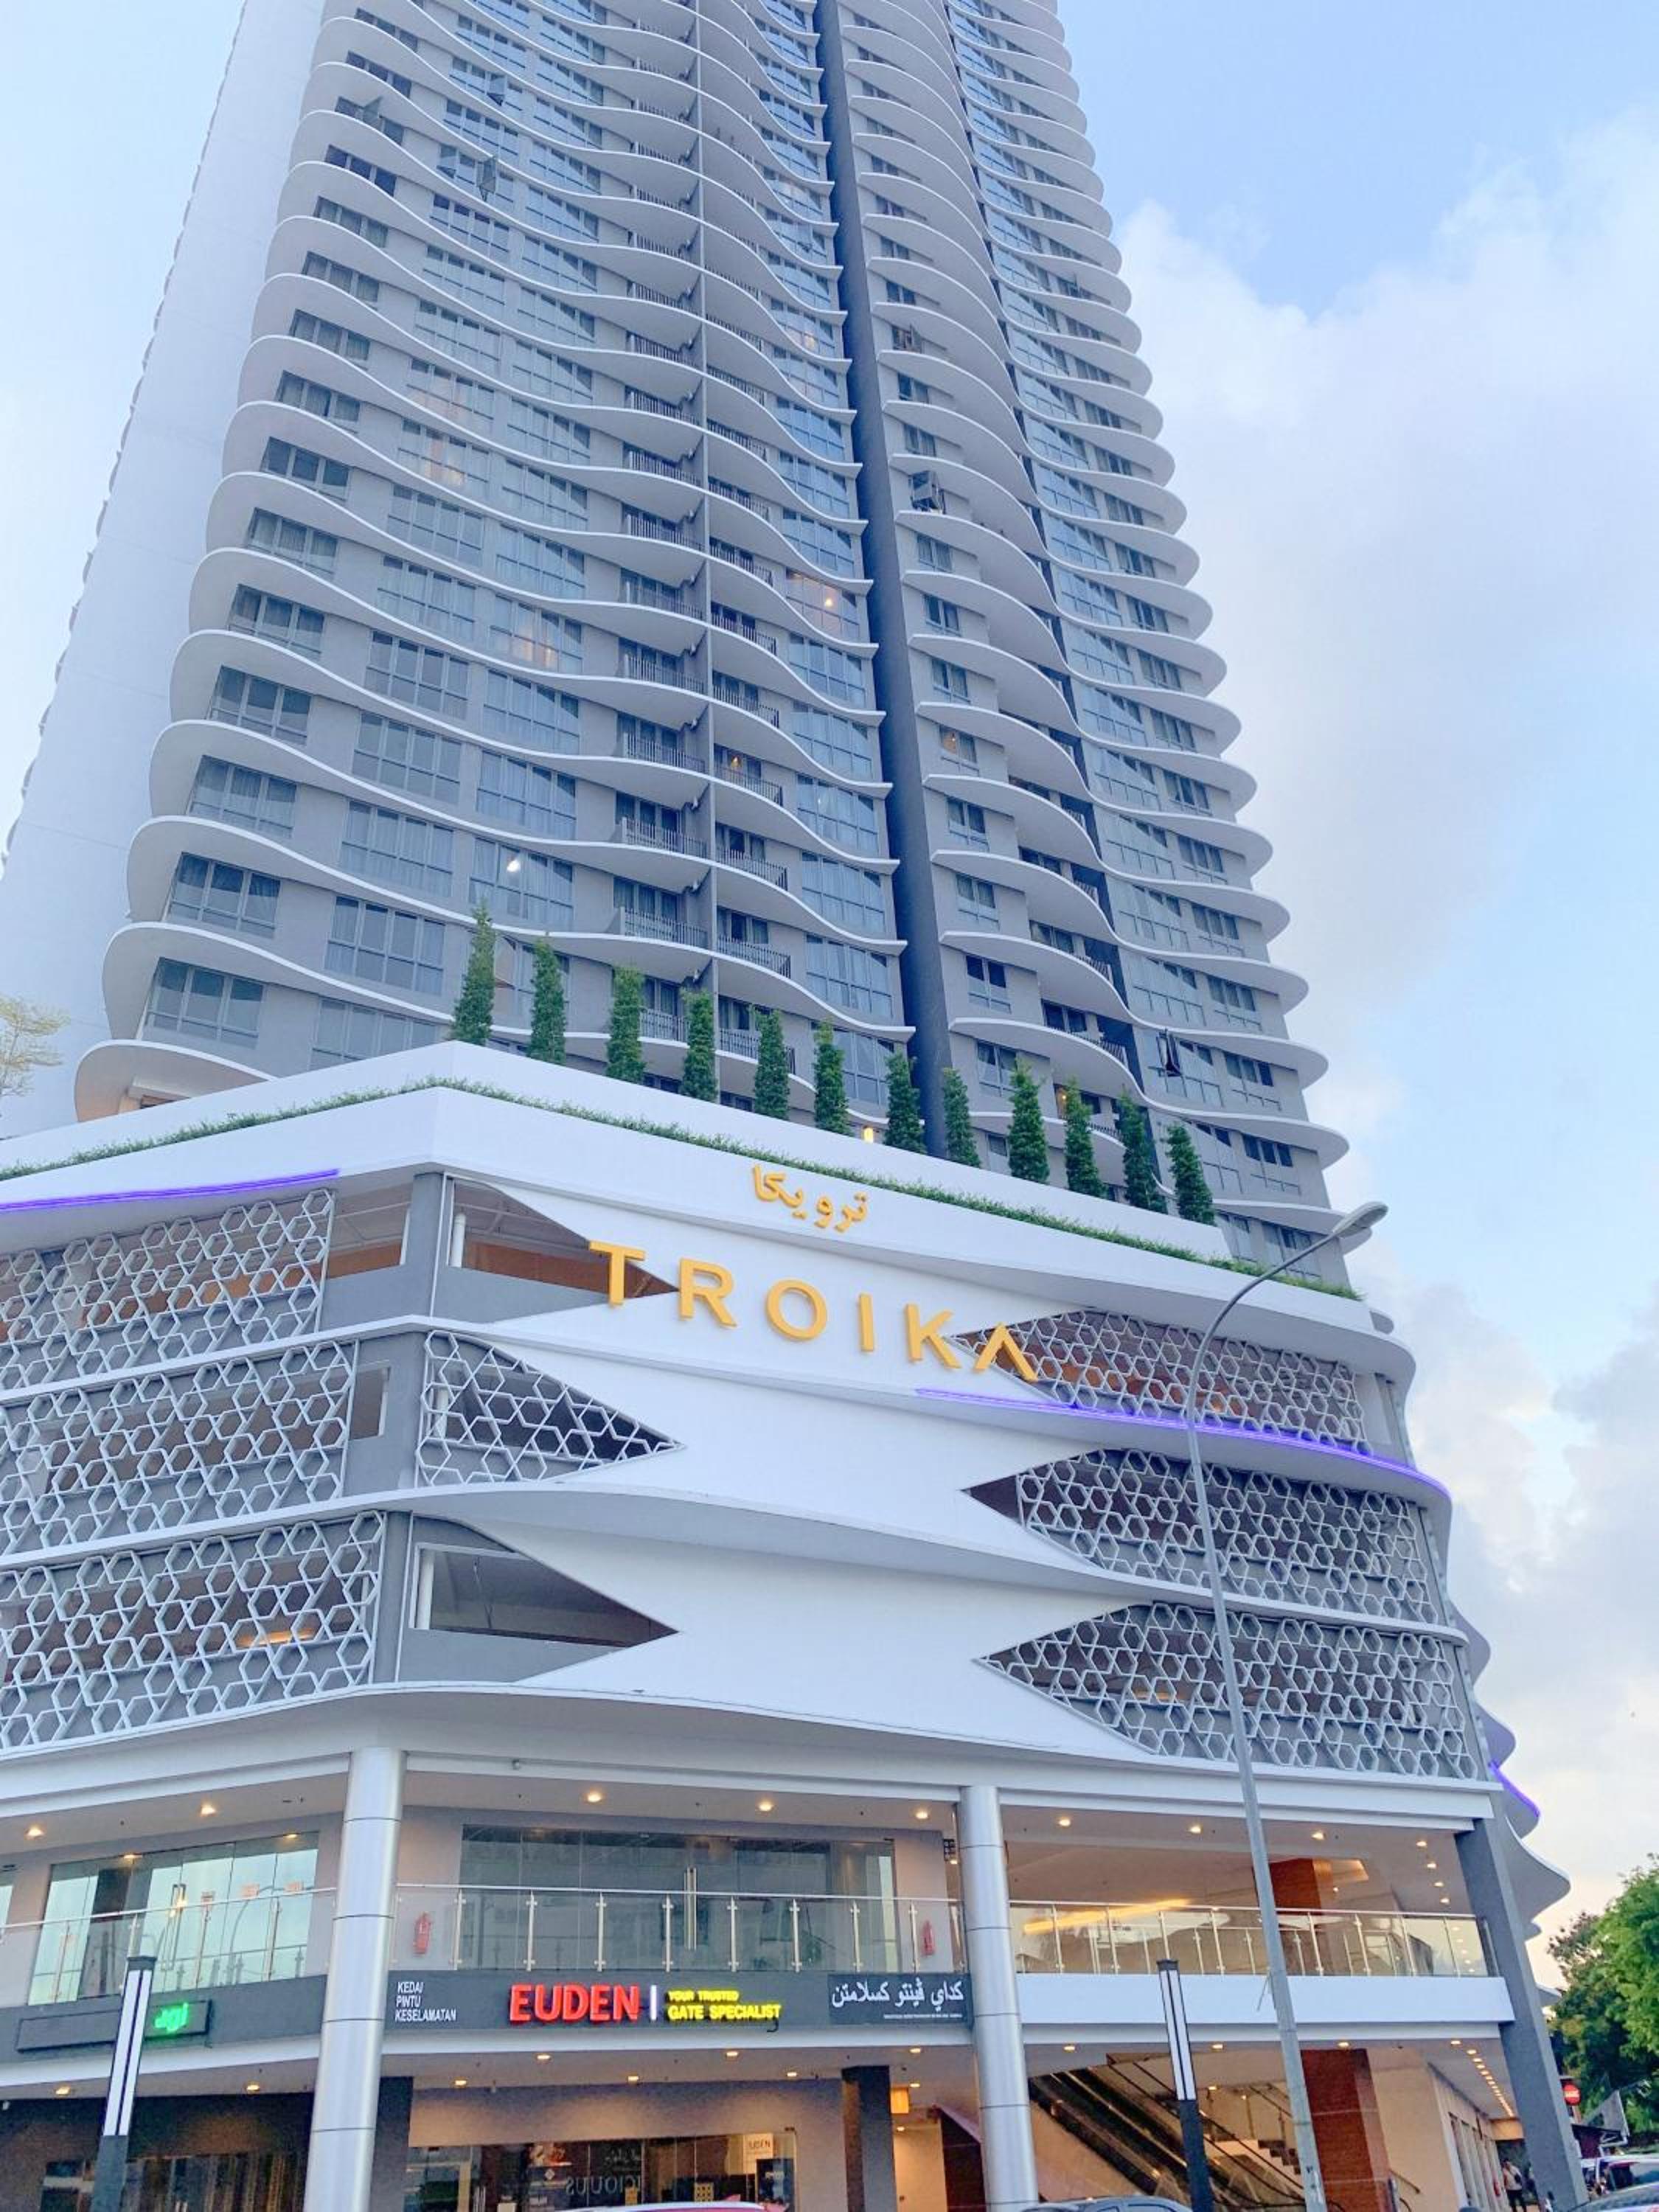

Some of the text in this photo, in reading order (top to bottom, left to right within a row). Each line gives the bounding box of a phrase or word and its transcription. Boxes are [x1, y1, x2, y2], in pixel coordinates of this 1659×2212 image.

[589, 1239, 1038, 1383] TROIKA
[397, 1980, 424, 1994] KEDAI
[396, 1994, 421, 2008] PINTU
[509, 1983, 640, 2022] EUDEN
[667, 1990, 740, 2002] YOUR TRUSTED
[394, 2008, 456, 2023] KESELAMATAN
[667, 2003, 782, 2020] GATE SPECIALIST
